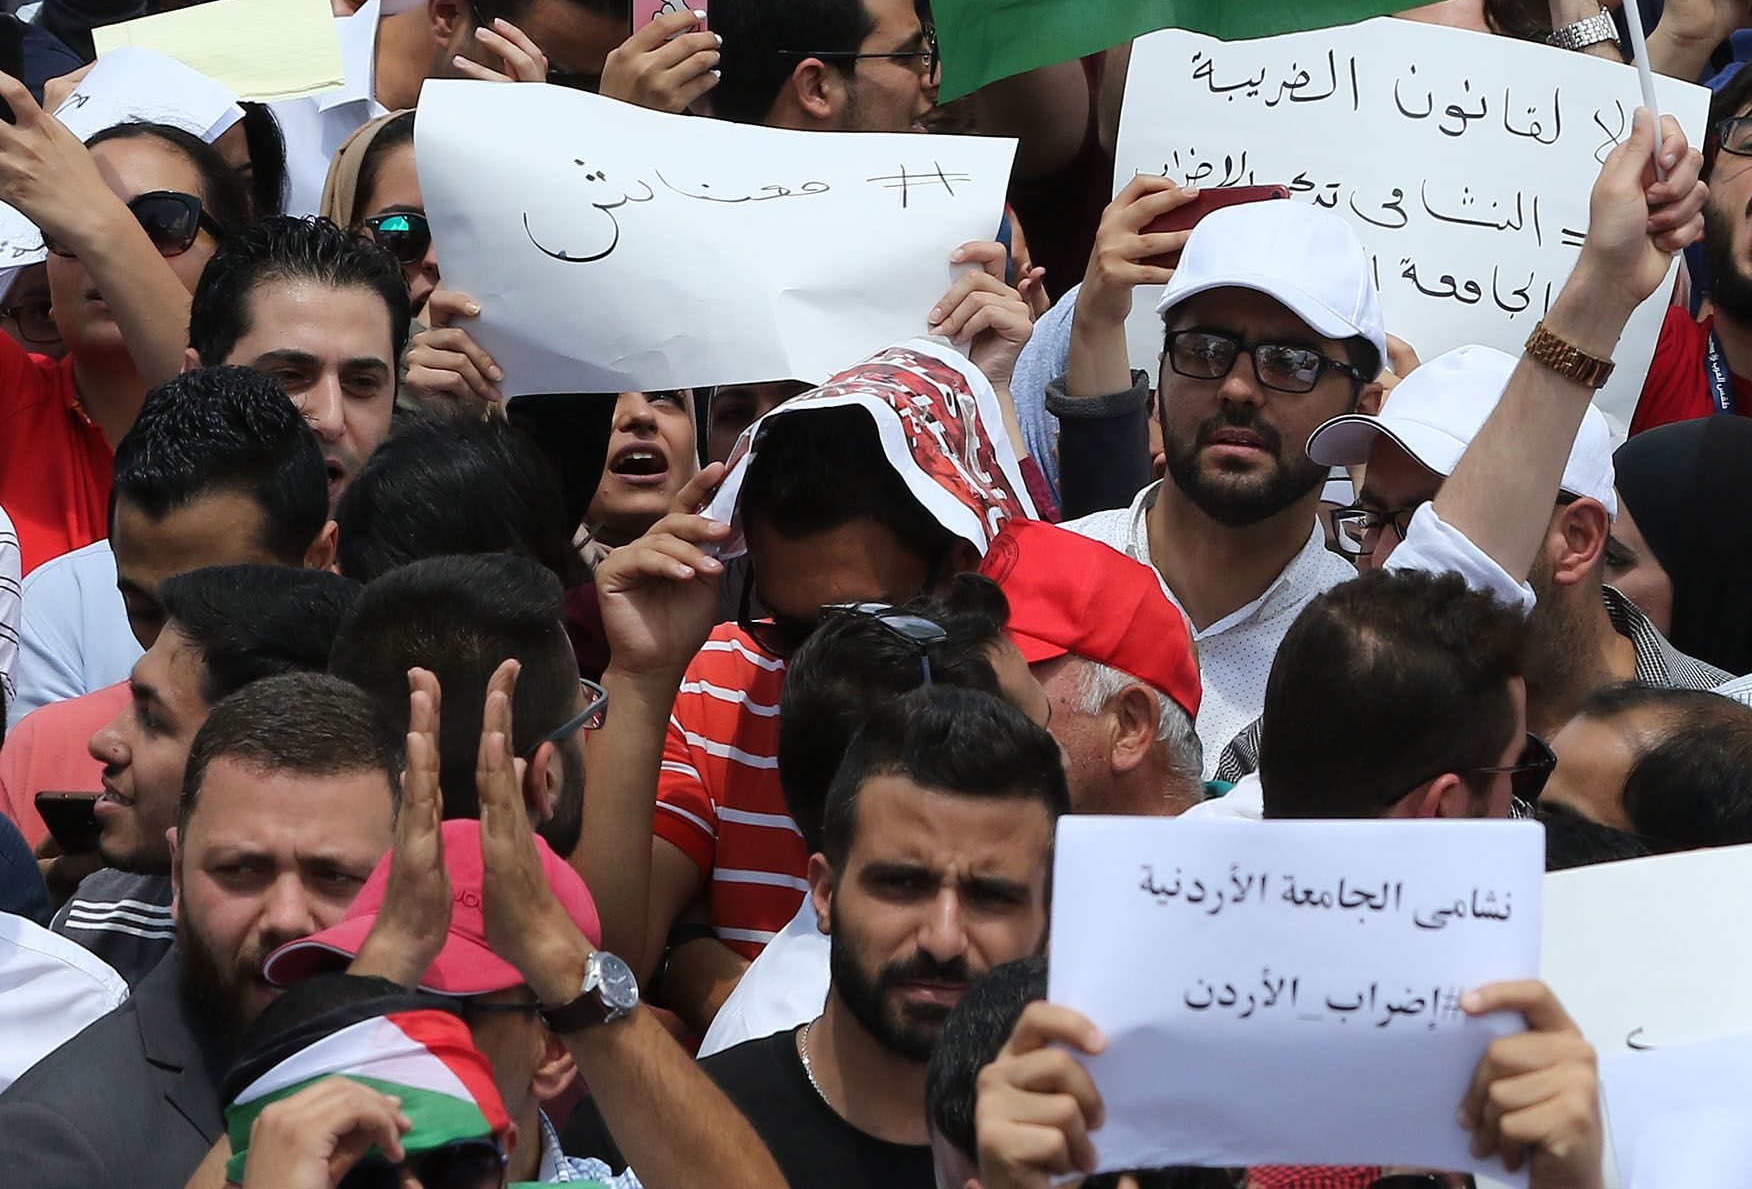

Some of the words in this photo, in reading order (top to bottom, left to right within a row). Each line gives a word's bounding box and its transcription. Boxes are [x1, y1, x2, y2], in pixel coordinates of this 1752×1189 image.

[1191, 48, 1359, 108] الضريبة
[1394, 63, 1562, 145] لقانون
[1139, 861, 1268, 915] الأردنية
[1282, 874, 1403, 925] الجامعة
[1412, 886, 1512, 930] نشامى
